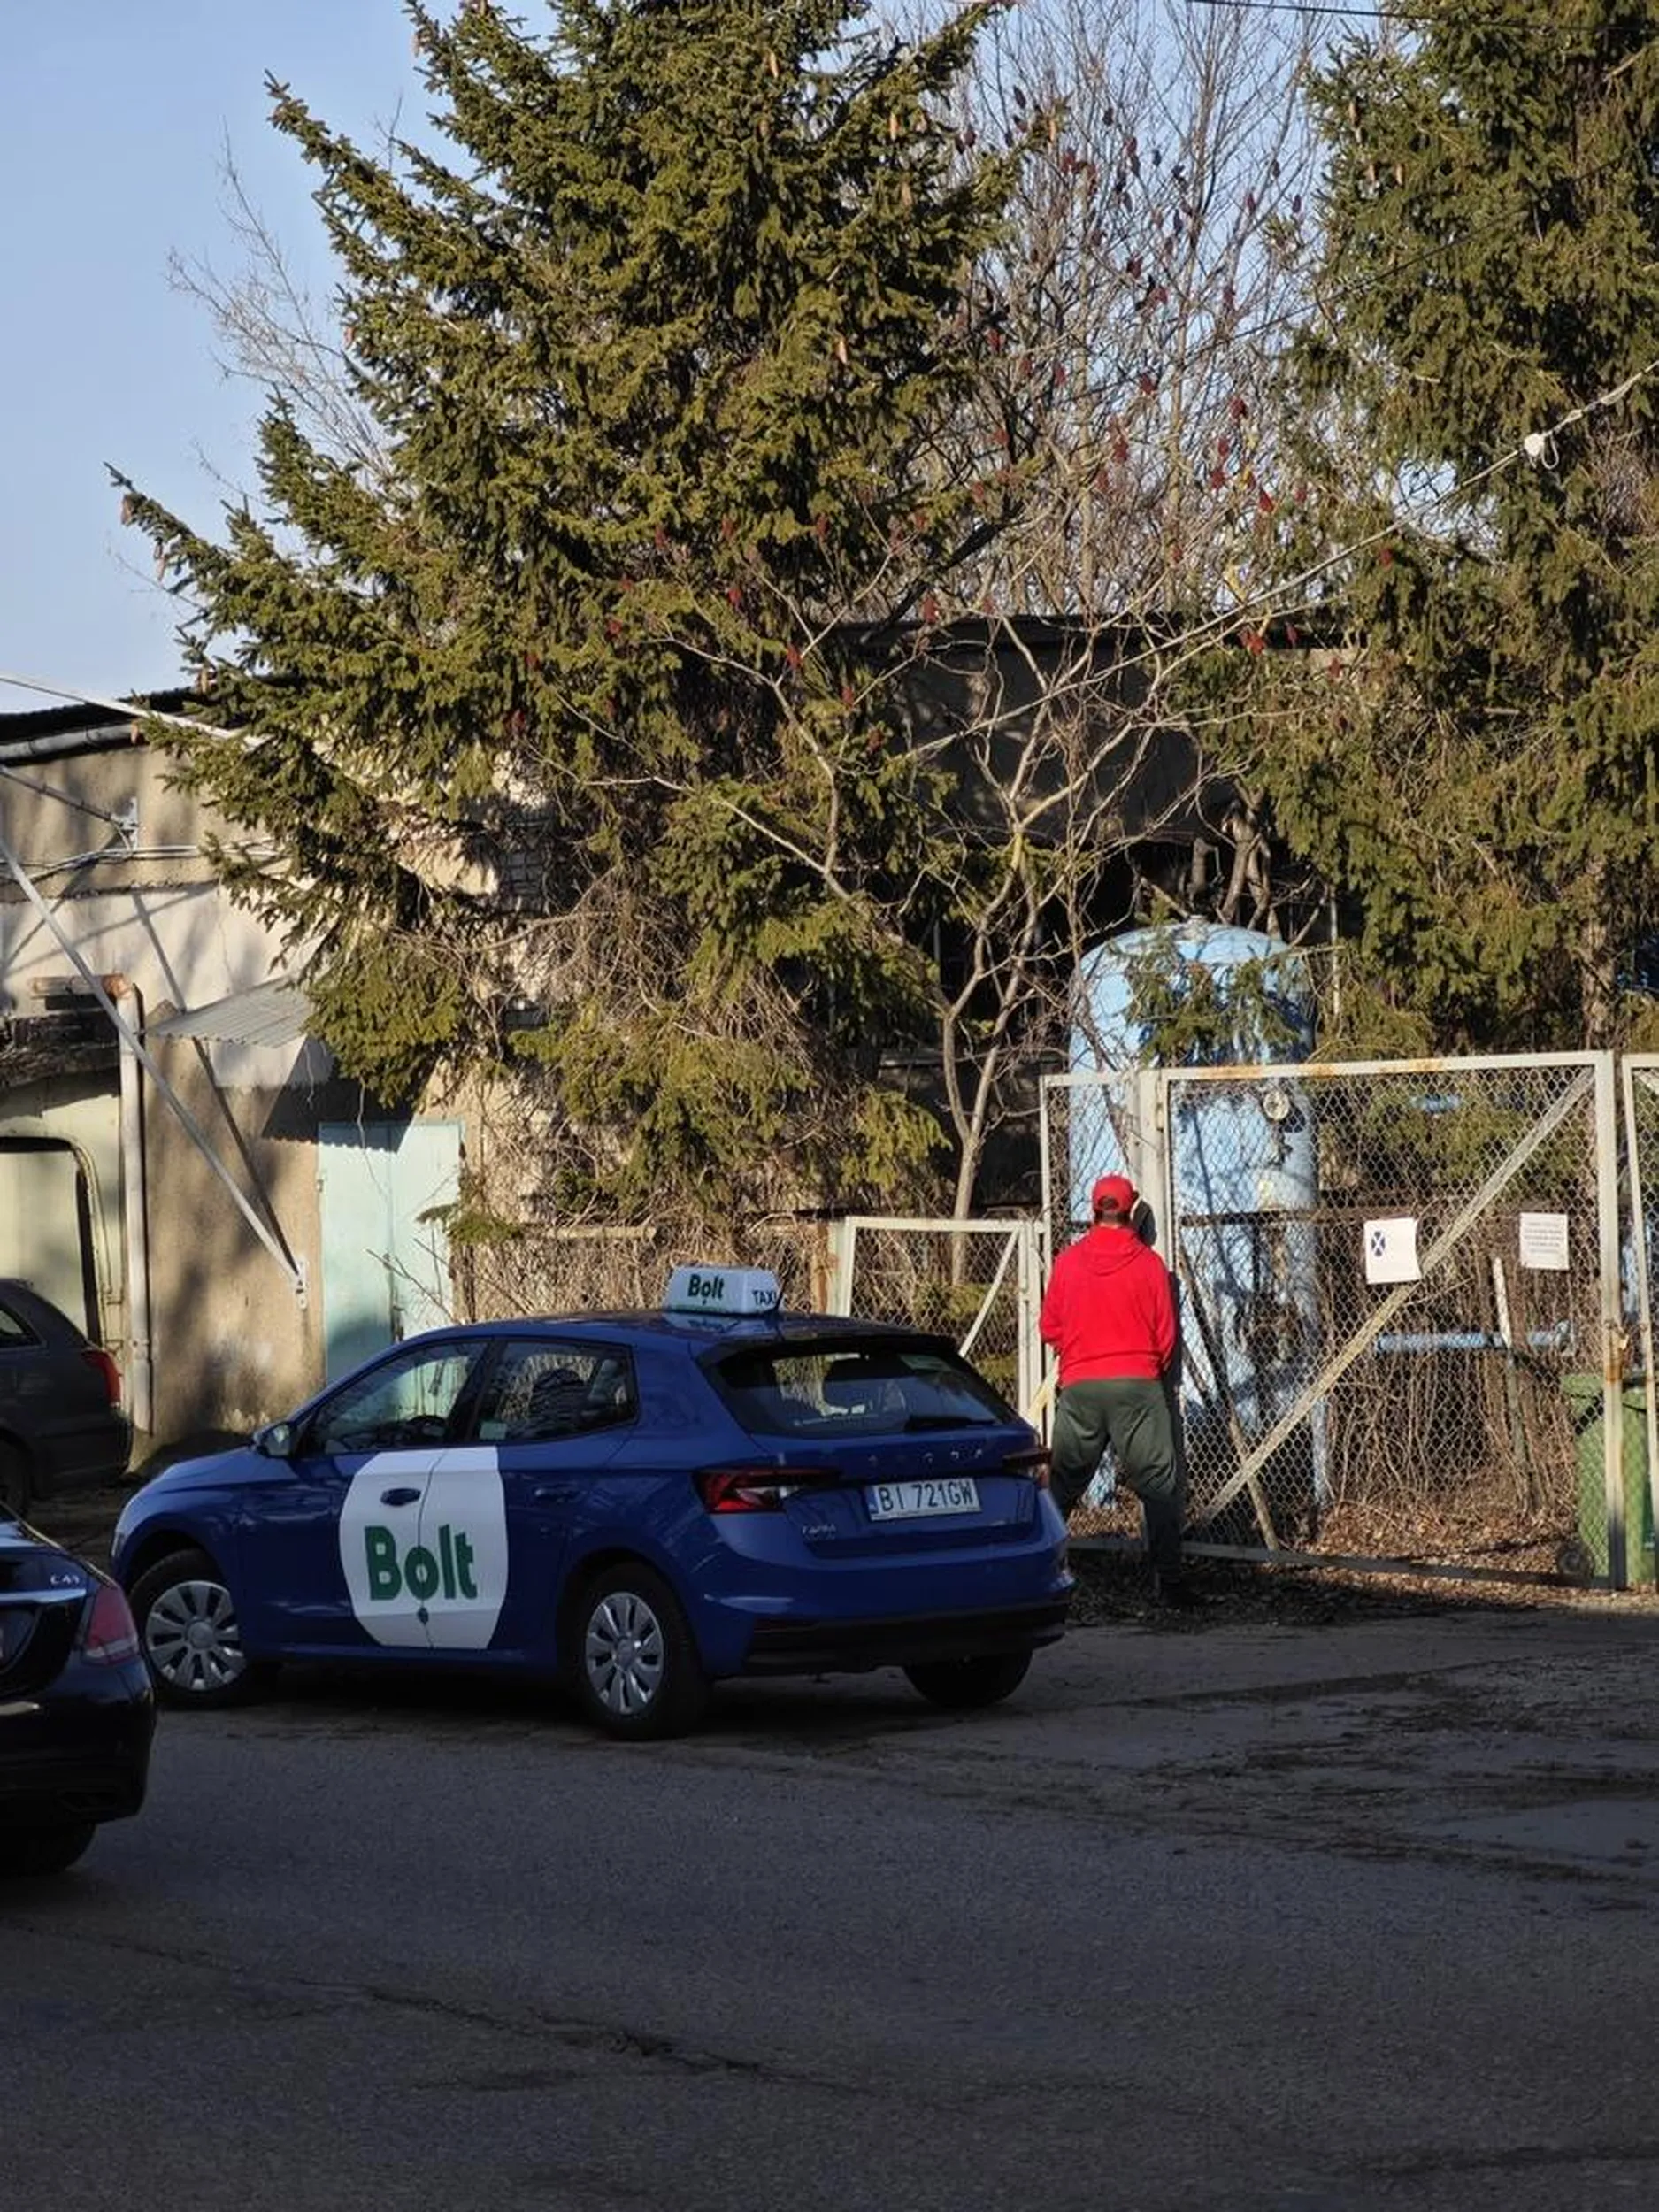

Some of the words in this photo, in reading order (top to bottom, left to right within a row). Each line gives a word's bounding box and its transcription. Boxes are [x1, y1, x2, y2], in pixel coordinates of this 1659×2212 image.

[687, 1274, 725, 1301] Bolt
[751, 1290, 777, 1306] TAXI
[879, 1486, 905, 1512] BI
[911, 1480, 974, 1509] 721GW
[364, 1524, 478, 1601] Bolt
